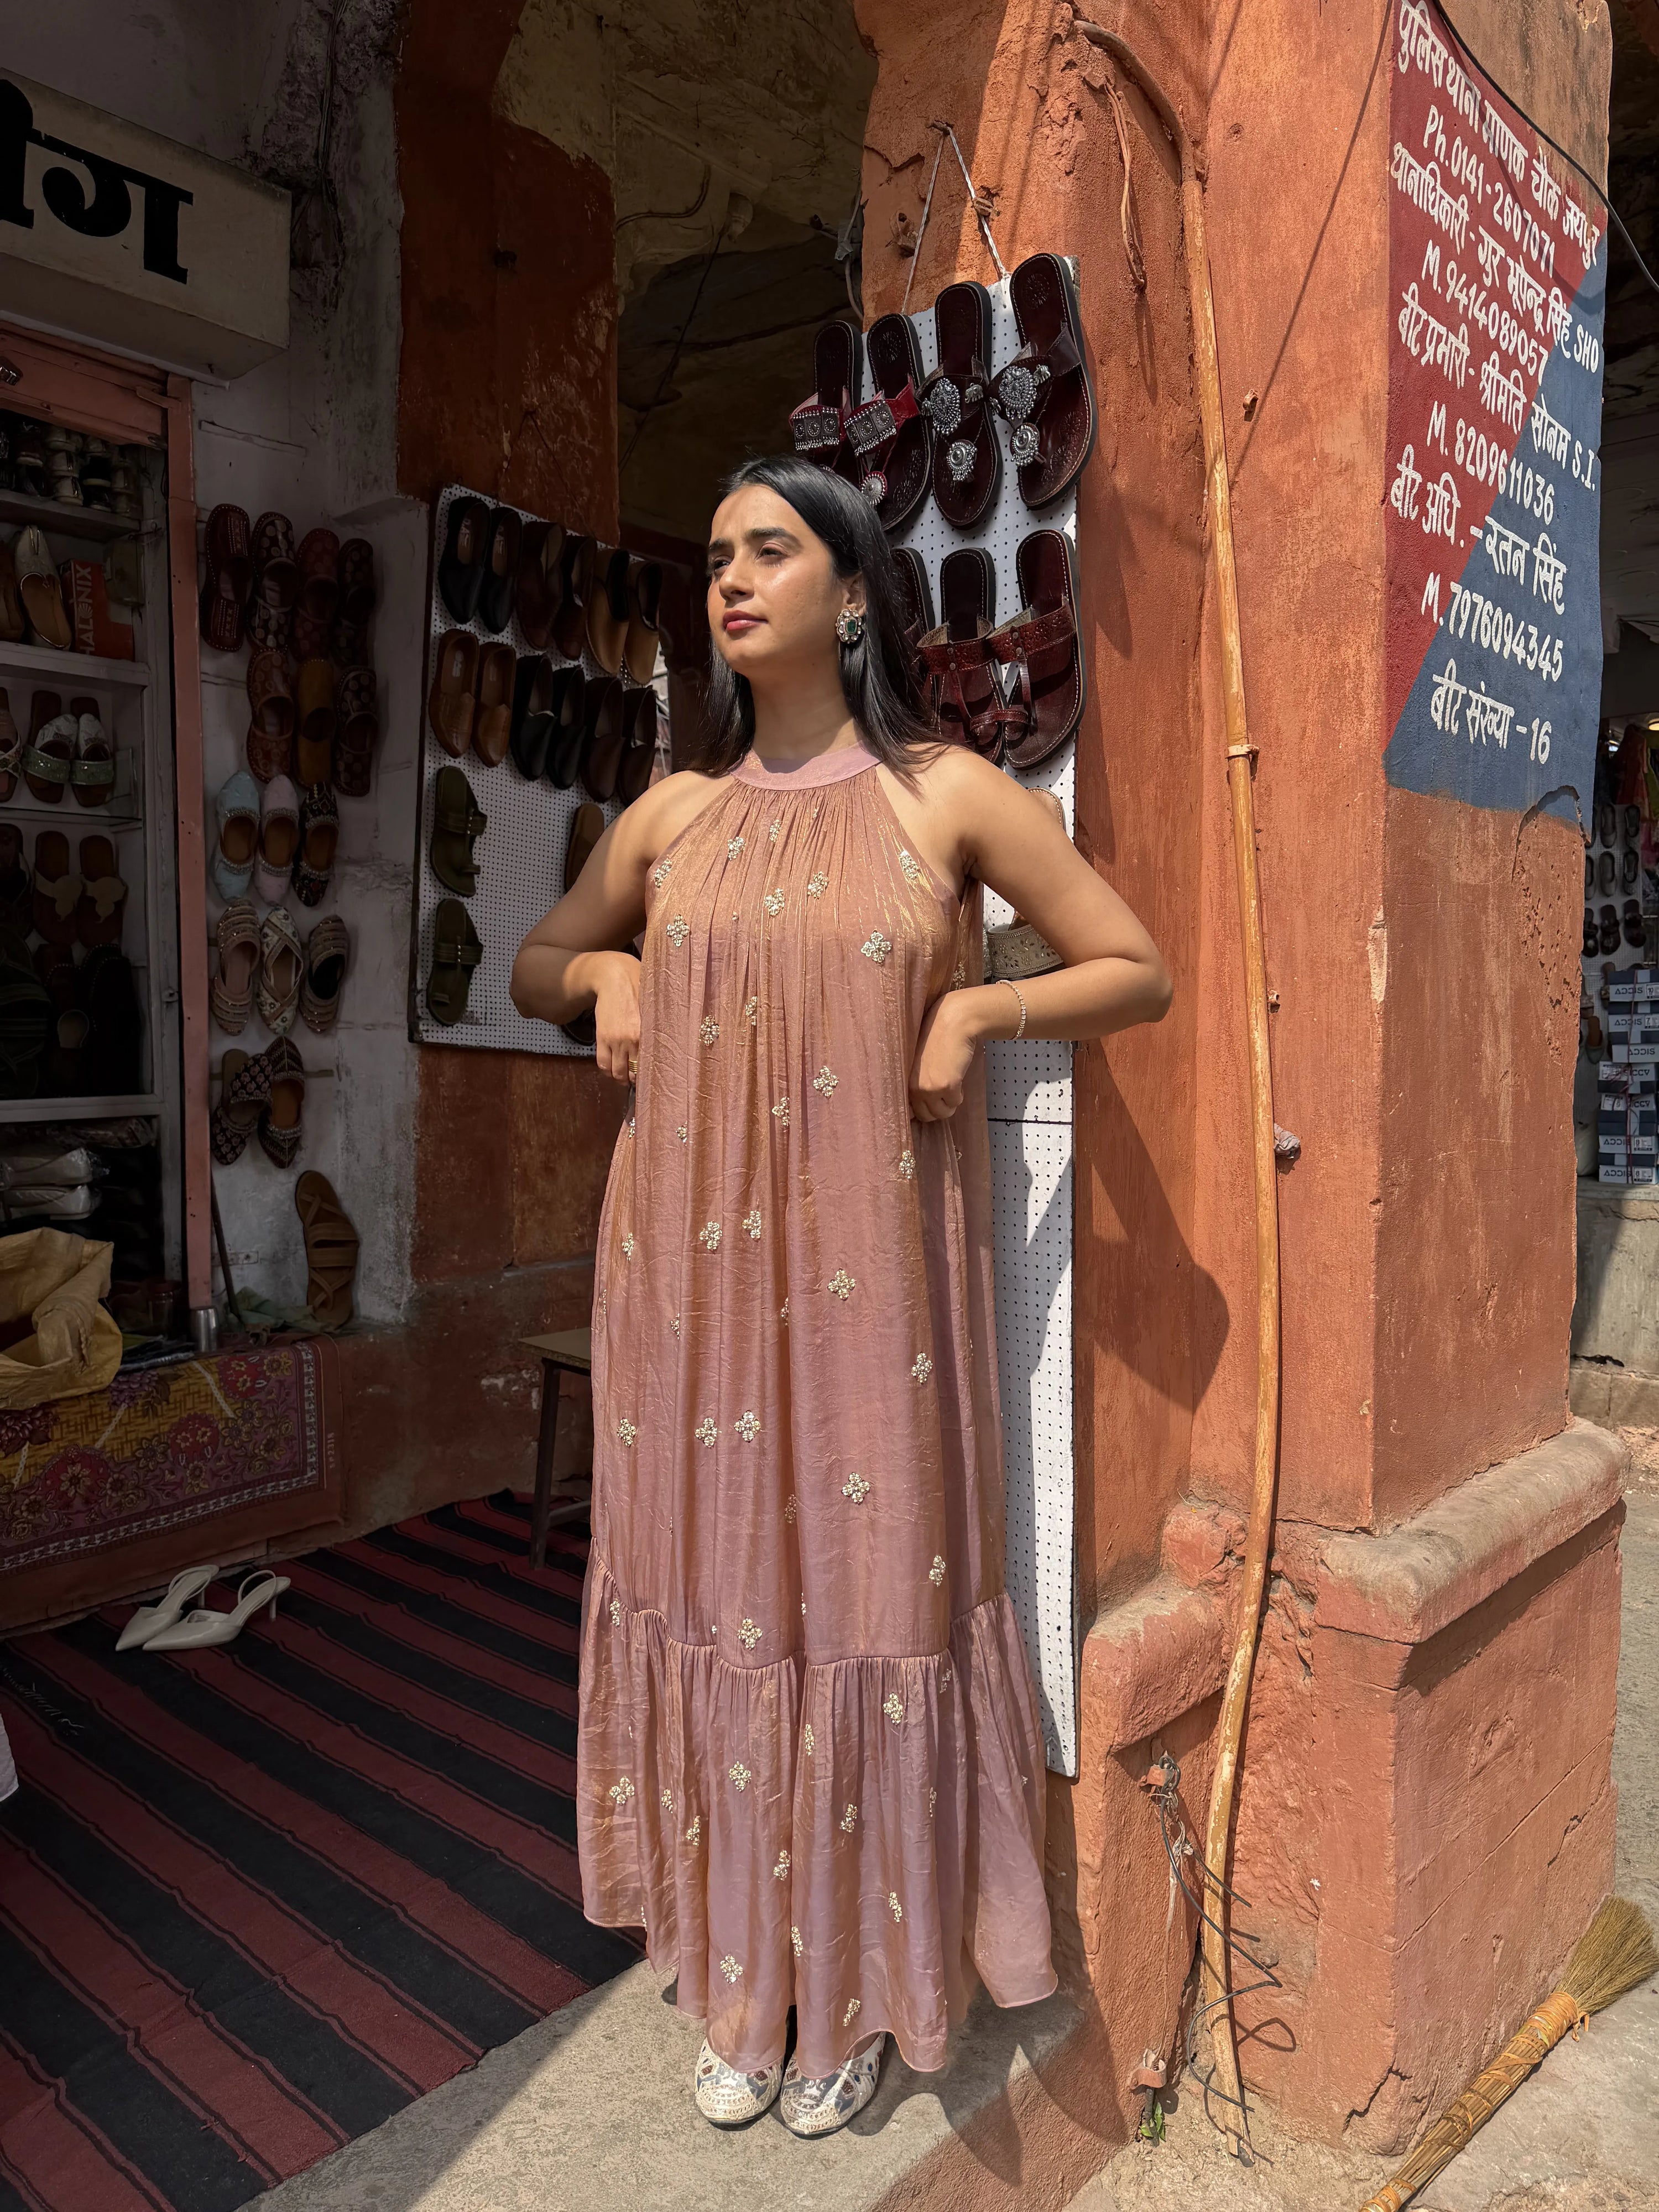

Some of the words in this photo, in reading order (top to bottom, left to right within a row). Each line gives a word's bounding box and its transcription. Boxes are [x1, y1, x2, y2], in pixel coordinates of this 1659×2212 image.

[1398, 0, 1448, 88] पुलिस
[1446, 56, 1481, 133] थाना
[1483, 99, 1528, 182] माणक
[1531, 145, 1561, 221] चौक
[1563, 195, 1600, 270] जयपुर
[1398, 282, 1427, 356] बीट
[1479, 351, 1527, 435] श्रीमति
[1531, 393, 1571, 469] सोनम
[1573, 440, 1596, 491] S.I.
[1547, 286, 1573, 359] सिंह
[1574, 324, 1599, 373] SHO
[1391, 444, 1422, 521] बीट
[1532, 533, 1568, 615] सिंह
[1430, 658, 1467, 735] बीट
[1466, 681, 1515, 749] संख्या
